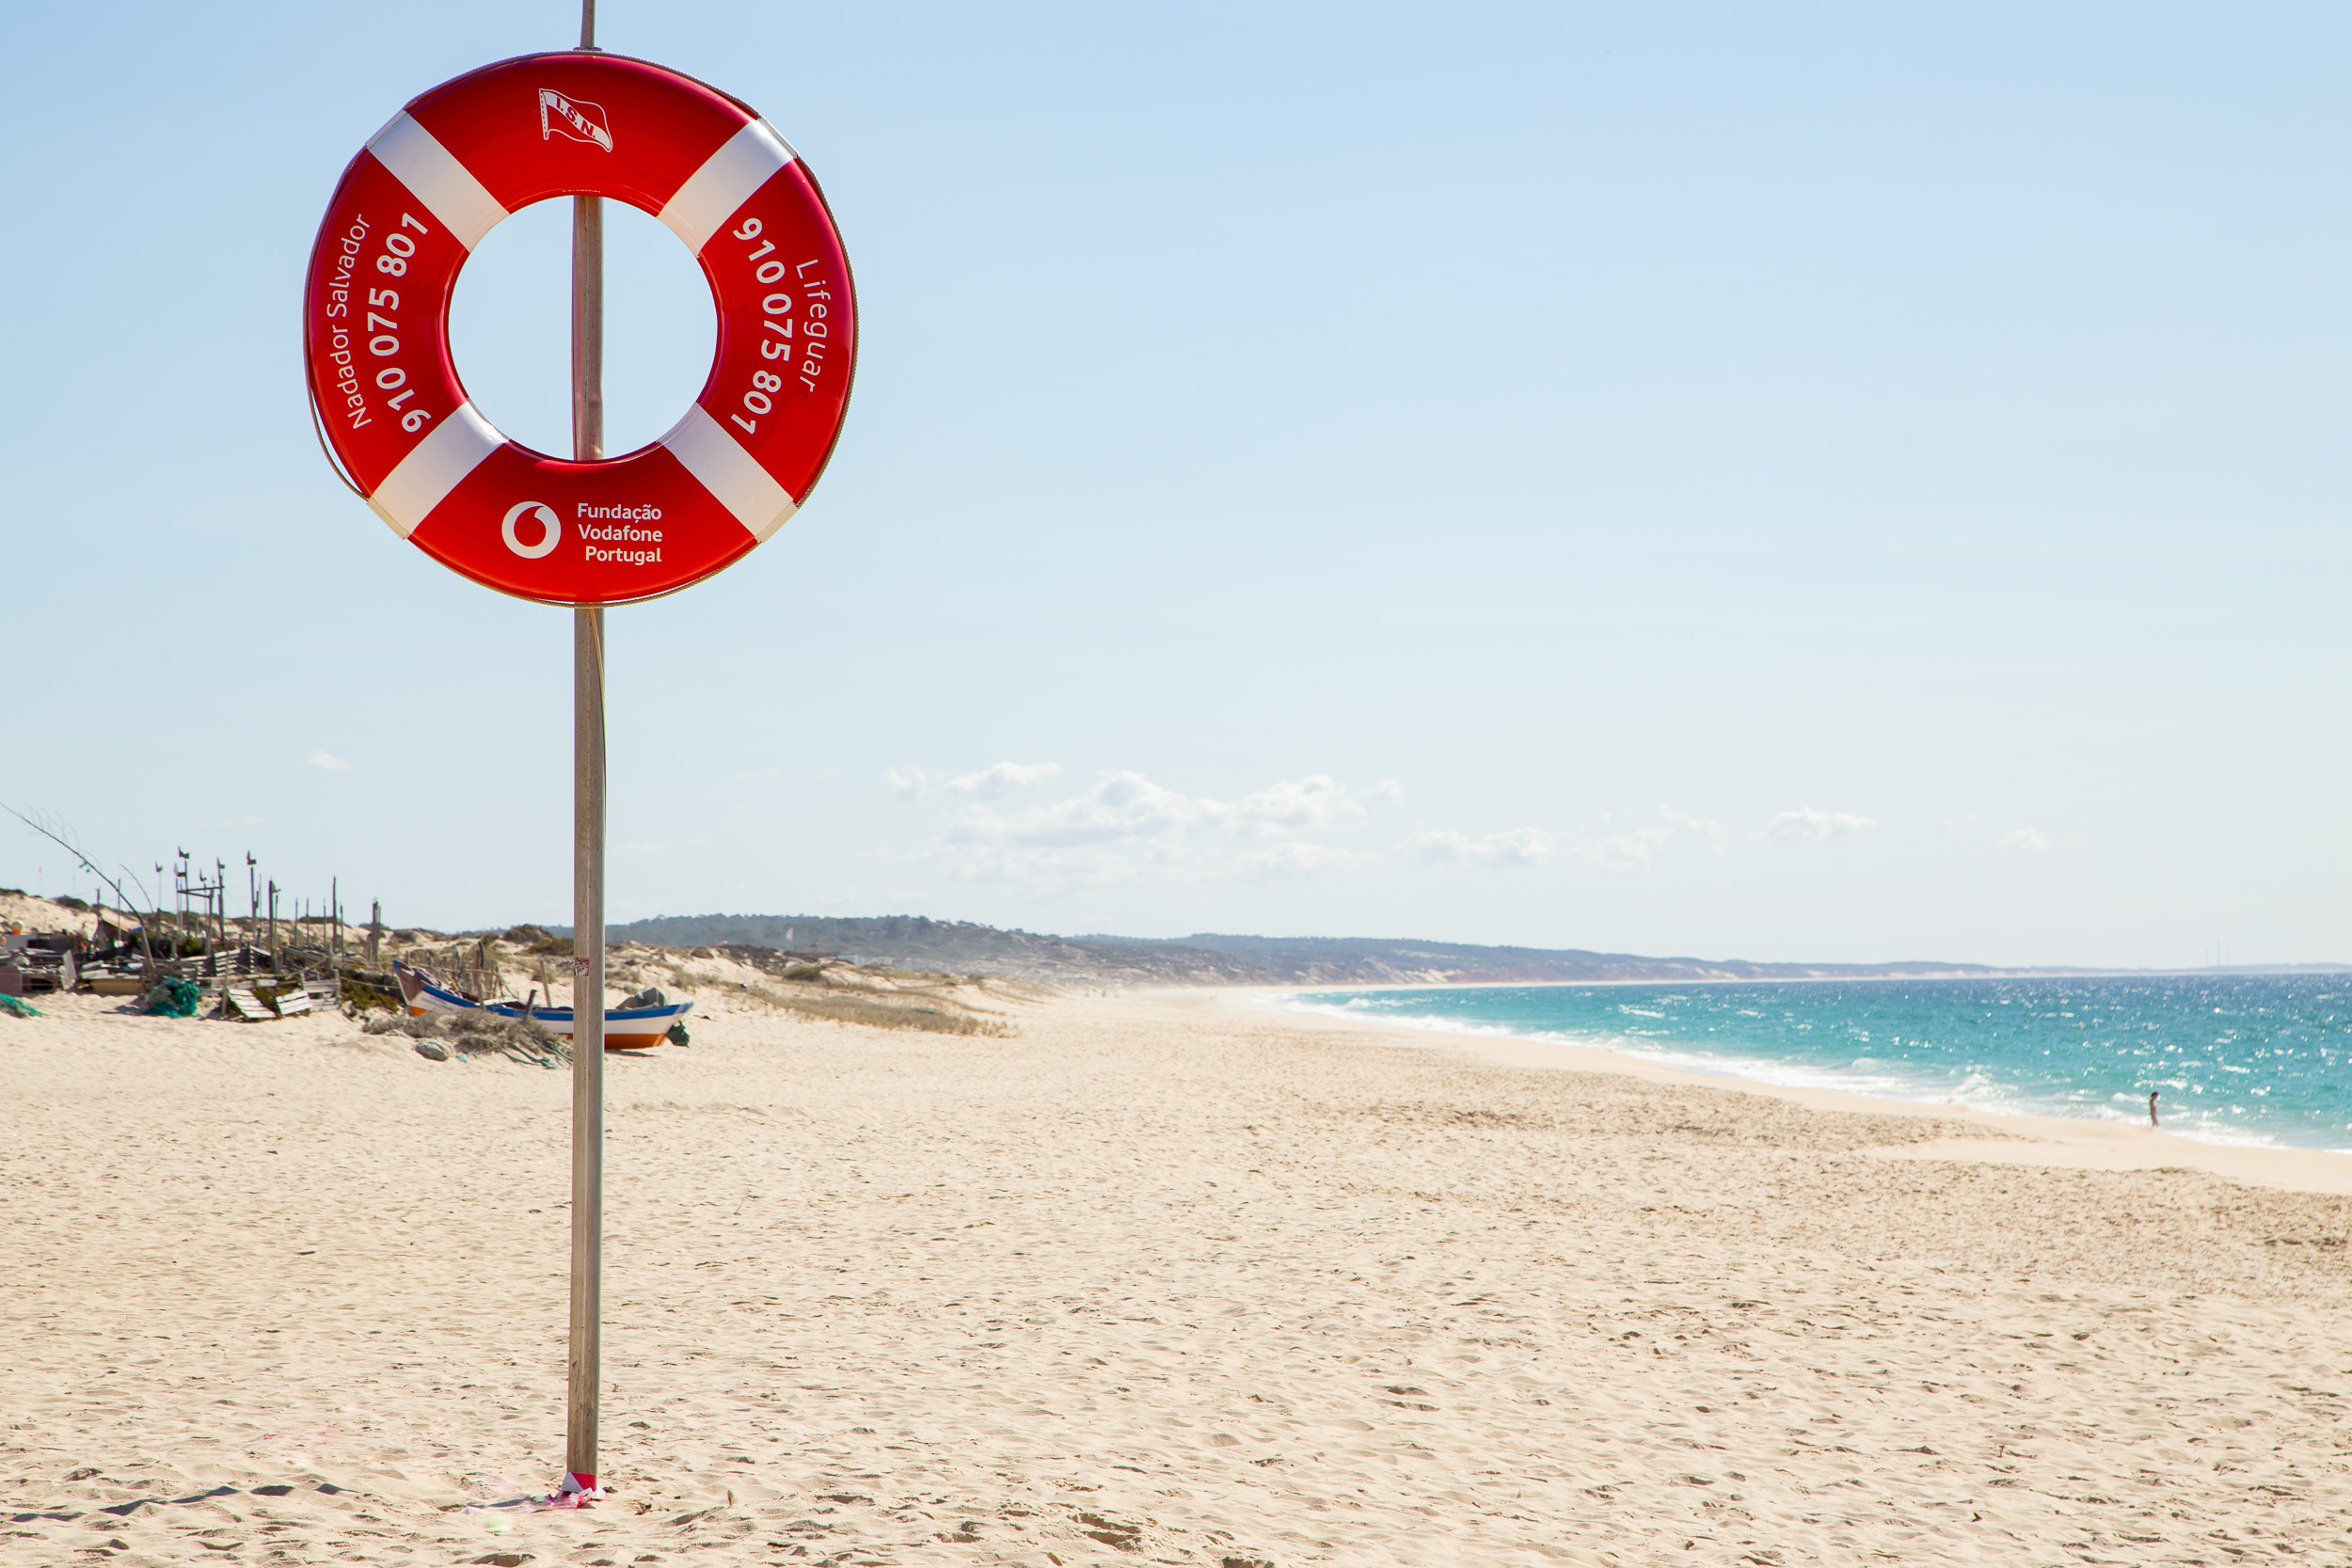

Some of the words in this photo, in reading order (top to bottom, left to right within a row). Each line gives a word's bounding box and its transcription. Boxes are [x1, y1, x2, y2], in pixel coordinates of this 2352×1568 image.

[326, 214, 371, 318] Salvador
[376, 212, 428, 277] 801
[732, 217, 786, 284] 910
[368, 288, 400, 356] 075
[761, 293, 793, 362] 075
[796, 259, 831, 393] Lifeguar
[329, 325, 373, 430] Nadador
[376, 367, 432, 434] 910
[730, 370, 782, 435] 801
[577, 502, 662, 524] Fundação
[578, 523, 663, 543] Vodafone
[585, 545, 662, 566] Portugal
